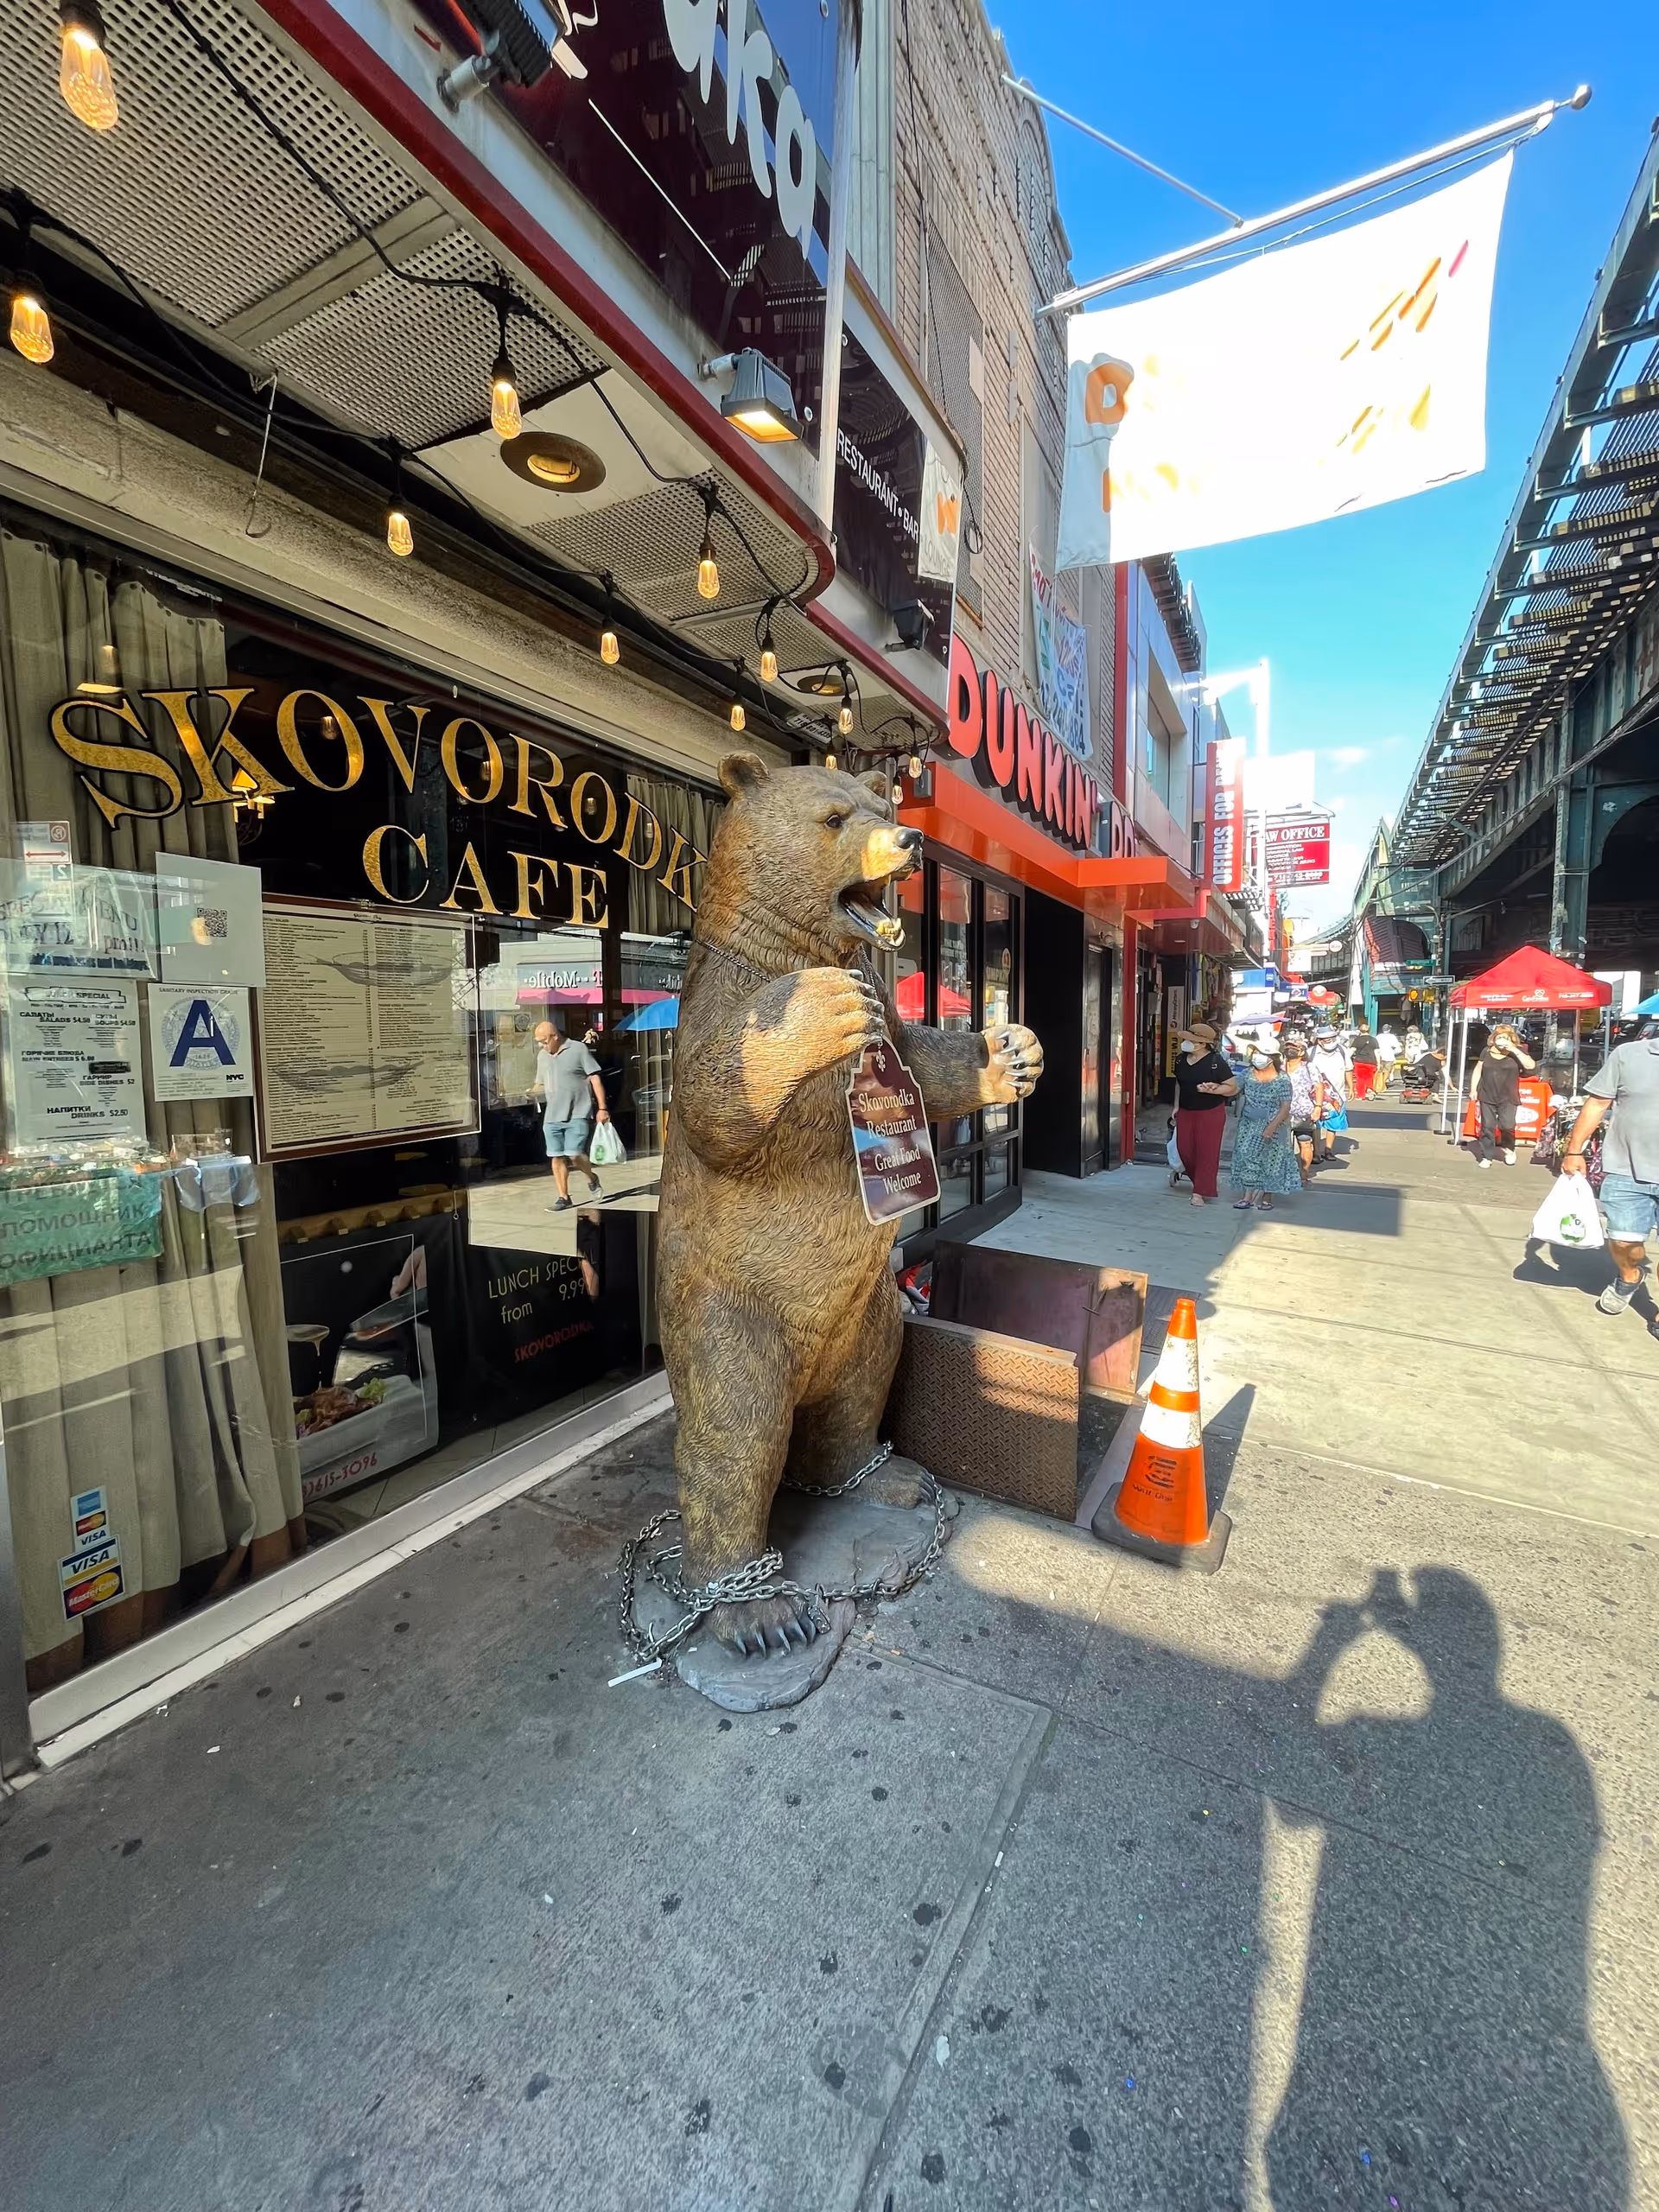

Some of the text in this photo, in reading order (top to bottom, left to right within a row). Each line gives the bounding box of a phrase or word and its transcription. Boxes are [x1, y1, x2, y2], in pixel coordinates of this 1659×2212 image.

[836, 428, 899, 517] RESTAURANT
[902, 507, 920, 545] BAR
[947, 632, 1098, 850] DUNKIN'
[1214, 790, 1236, 821] FOR
[1281, 826, 1325, 841] OFFICE
[1212, 824, 1235, 885] OFFICES
[363, 824, 609, 929] CAFE
[168, 999, 237, 1067] A
[857, 1088, 915, 1114] Skovorodka
[866, 1114, 917, 1140] Restaurant
[874, 1143, 922, 1173] Great Food
[882, 1171, 922, 1196] Welcome
[488, 1249, 598, 1299] LUNCH SPECL
[500, 1302, 533, 1325] from
[514, 1320, 594, 1363] SKOVORODKA
[81, 1529, 107, 1546] VISA
[72, 1549, 110, 1574] VISA
[68, 1578, 119, 1608] MasterCard
